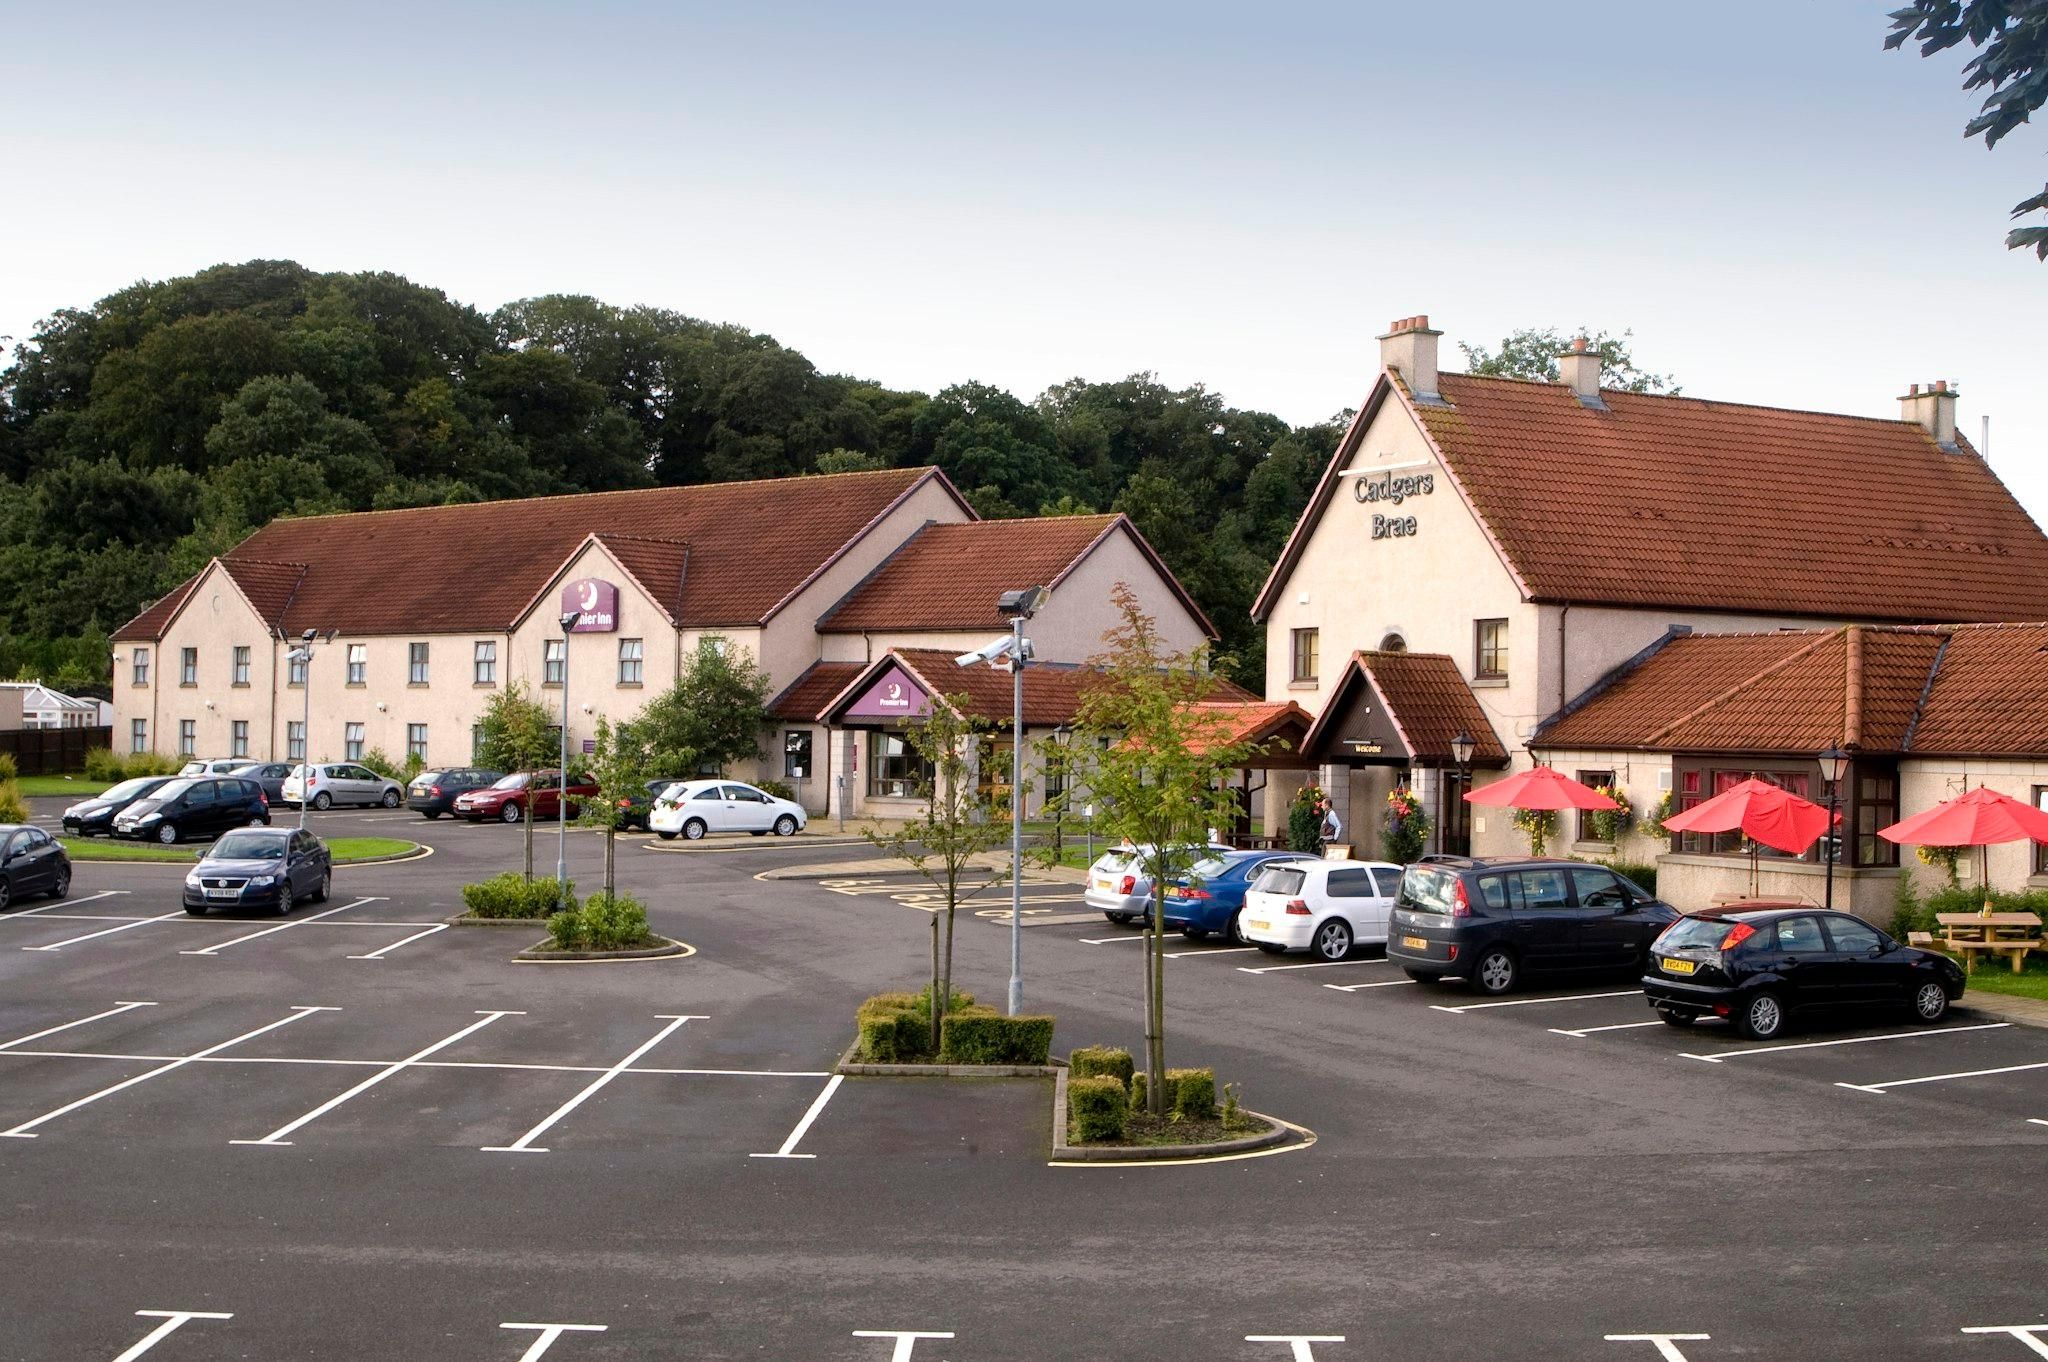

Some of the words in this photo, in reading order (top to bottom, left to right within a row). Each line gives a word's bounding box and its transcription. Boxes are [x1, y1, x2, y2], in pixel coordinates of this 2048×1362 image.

[1355, 471, 1434, 505] Cadgers
[1371, 514, 1417, 540] Brae
[597, 611, 612, 625] Inn
[880, 698, 899, 706] Premier
[899, 698, 909, 706] Inn
